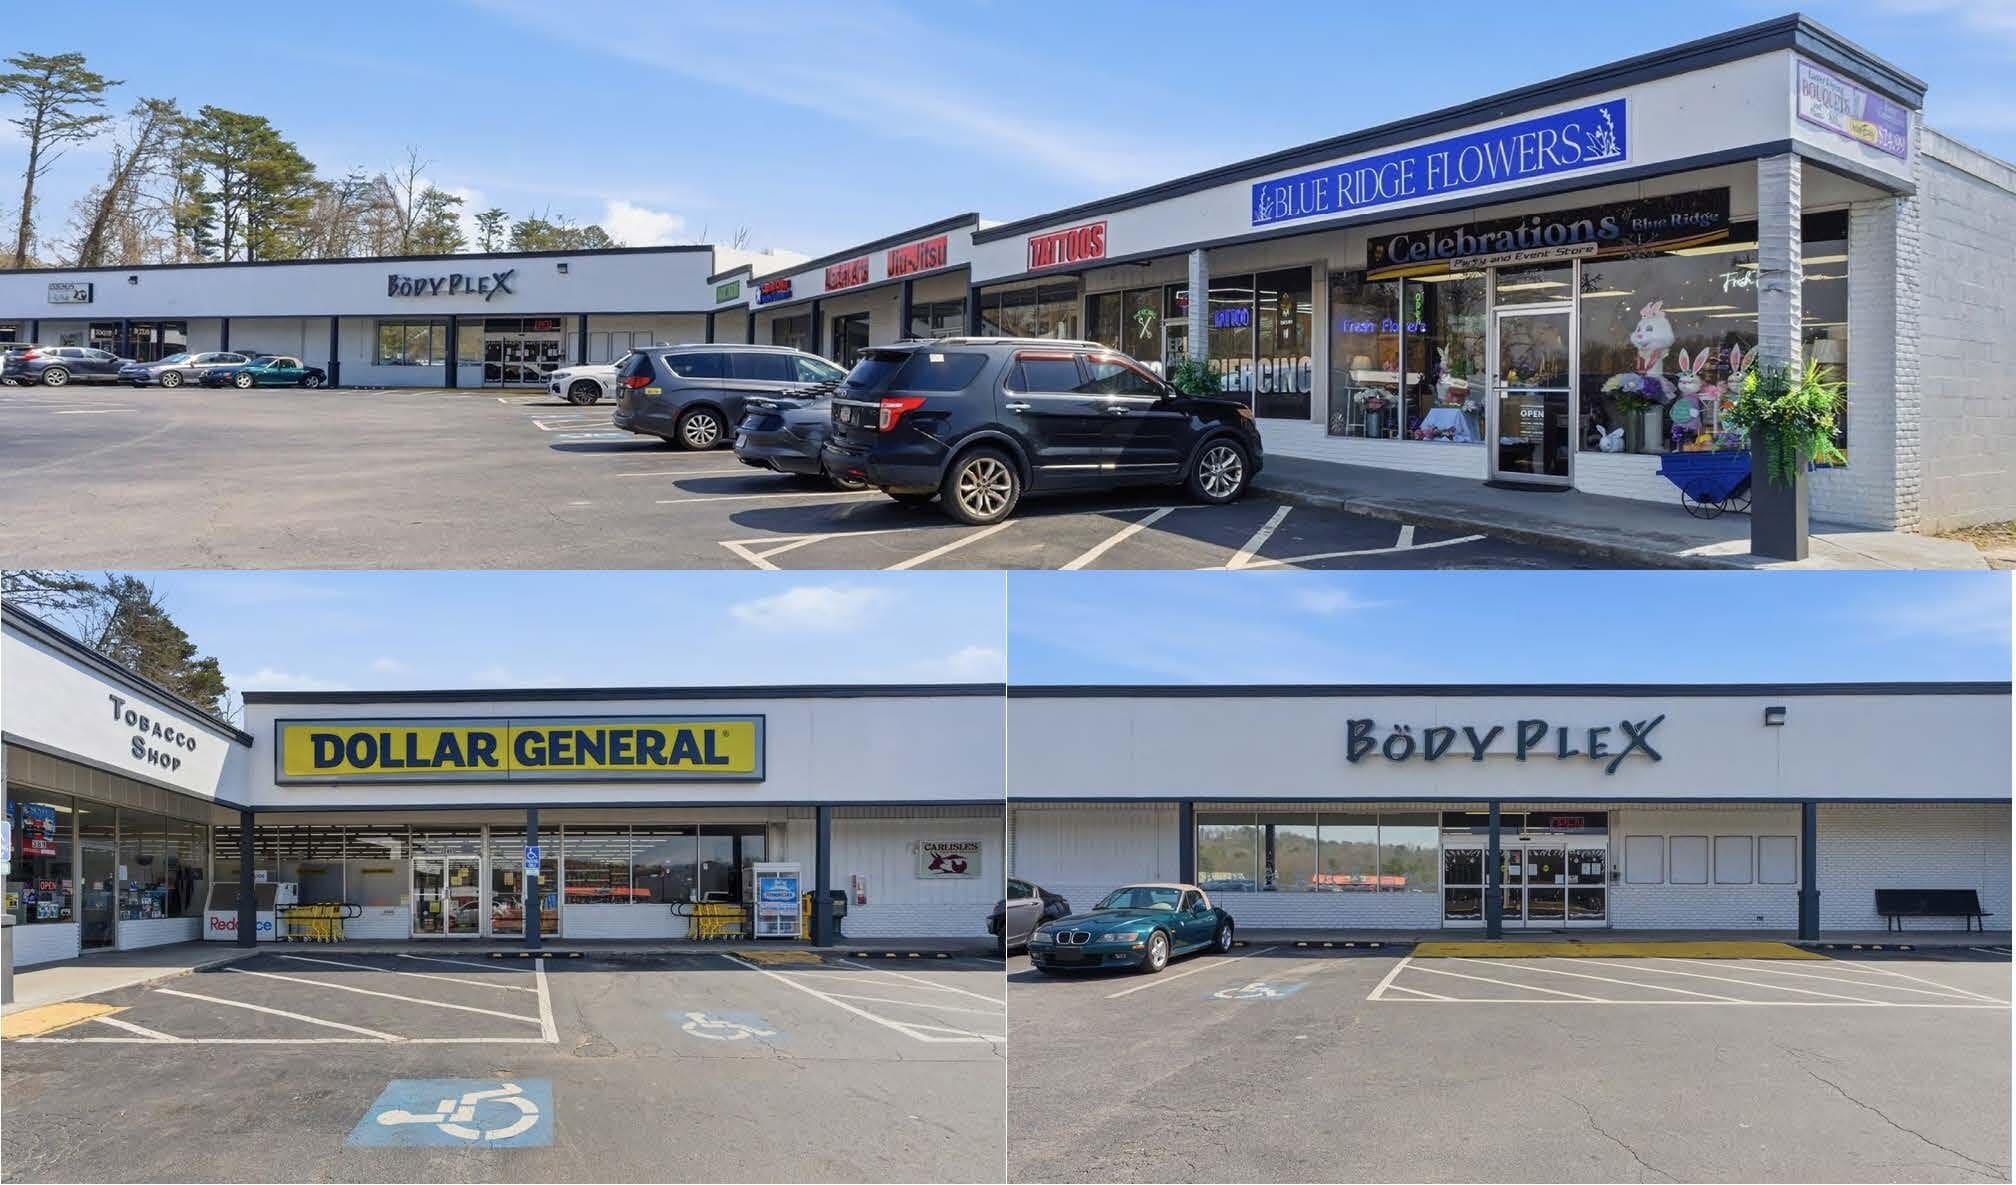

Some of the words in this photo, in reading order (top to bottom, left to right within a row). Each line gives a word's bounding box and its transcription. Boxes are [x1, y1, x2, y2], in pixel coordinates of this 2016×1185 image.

[1274, 177, 1329, 218] BLUE
[1337, 158, 1416, 208] RIDGE
[1426, 123, 1582, 191] FLOWERS
[1388, 214, 1622, 265] Celebrations
[1632, 217, 1668, 231] Blue
[1671, 212, 1720, 227] Ridge
[887, 236, 947, 277] Jiu-Jitsu
[1031, 225, 1104, 267] TATTOOS
[1453, 256, 1487, 268] Party
[1490, 254, 1513, 265] and
[1515, 250, 1551, 262] Event
[1555, 244, 1595, 258] Store
[1343, 319, 1375, 333] Fresh
[1382, 319, 1427, 333] Floers
[1520, 409, 1545, 418] OPEN
[109, 694, 196, 752] TOBACCO
[131, 735, 182, 772] SHOP
[311, 731, 499, 769] DOLLAR
[513, 728, 729, 767] GENERAL
[40, 881, 57, 890] OPEN
[210, 916, 238, 930] Red
[255, 921, 272, 931] ce
